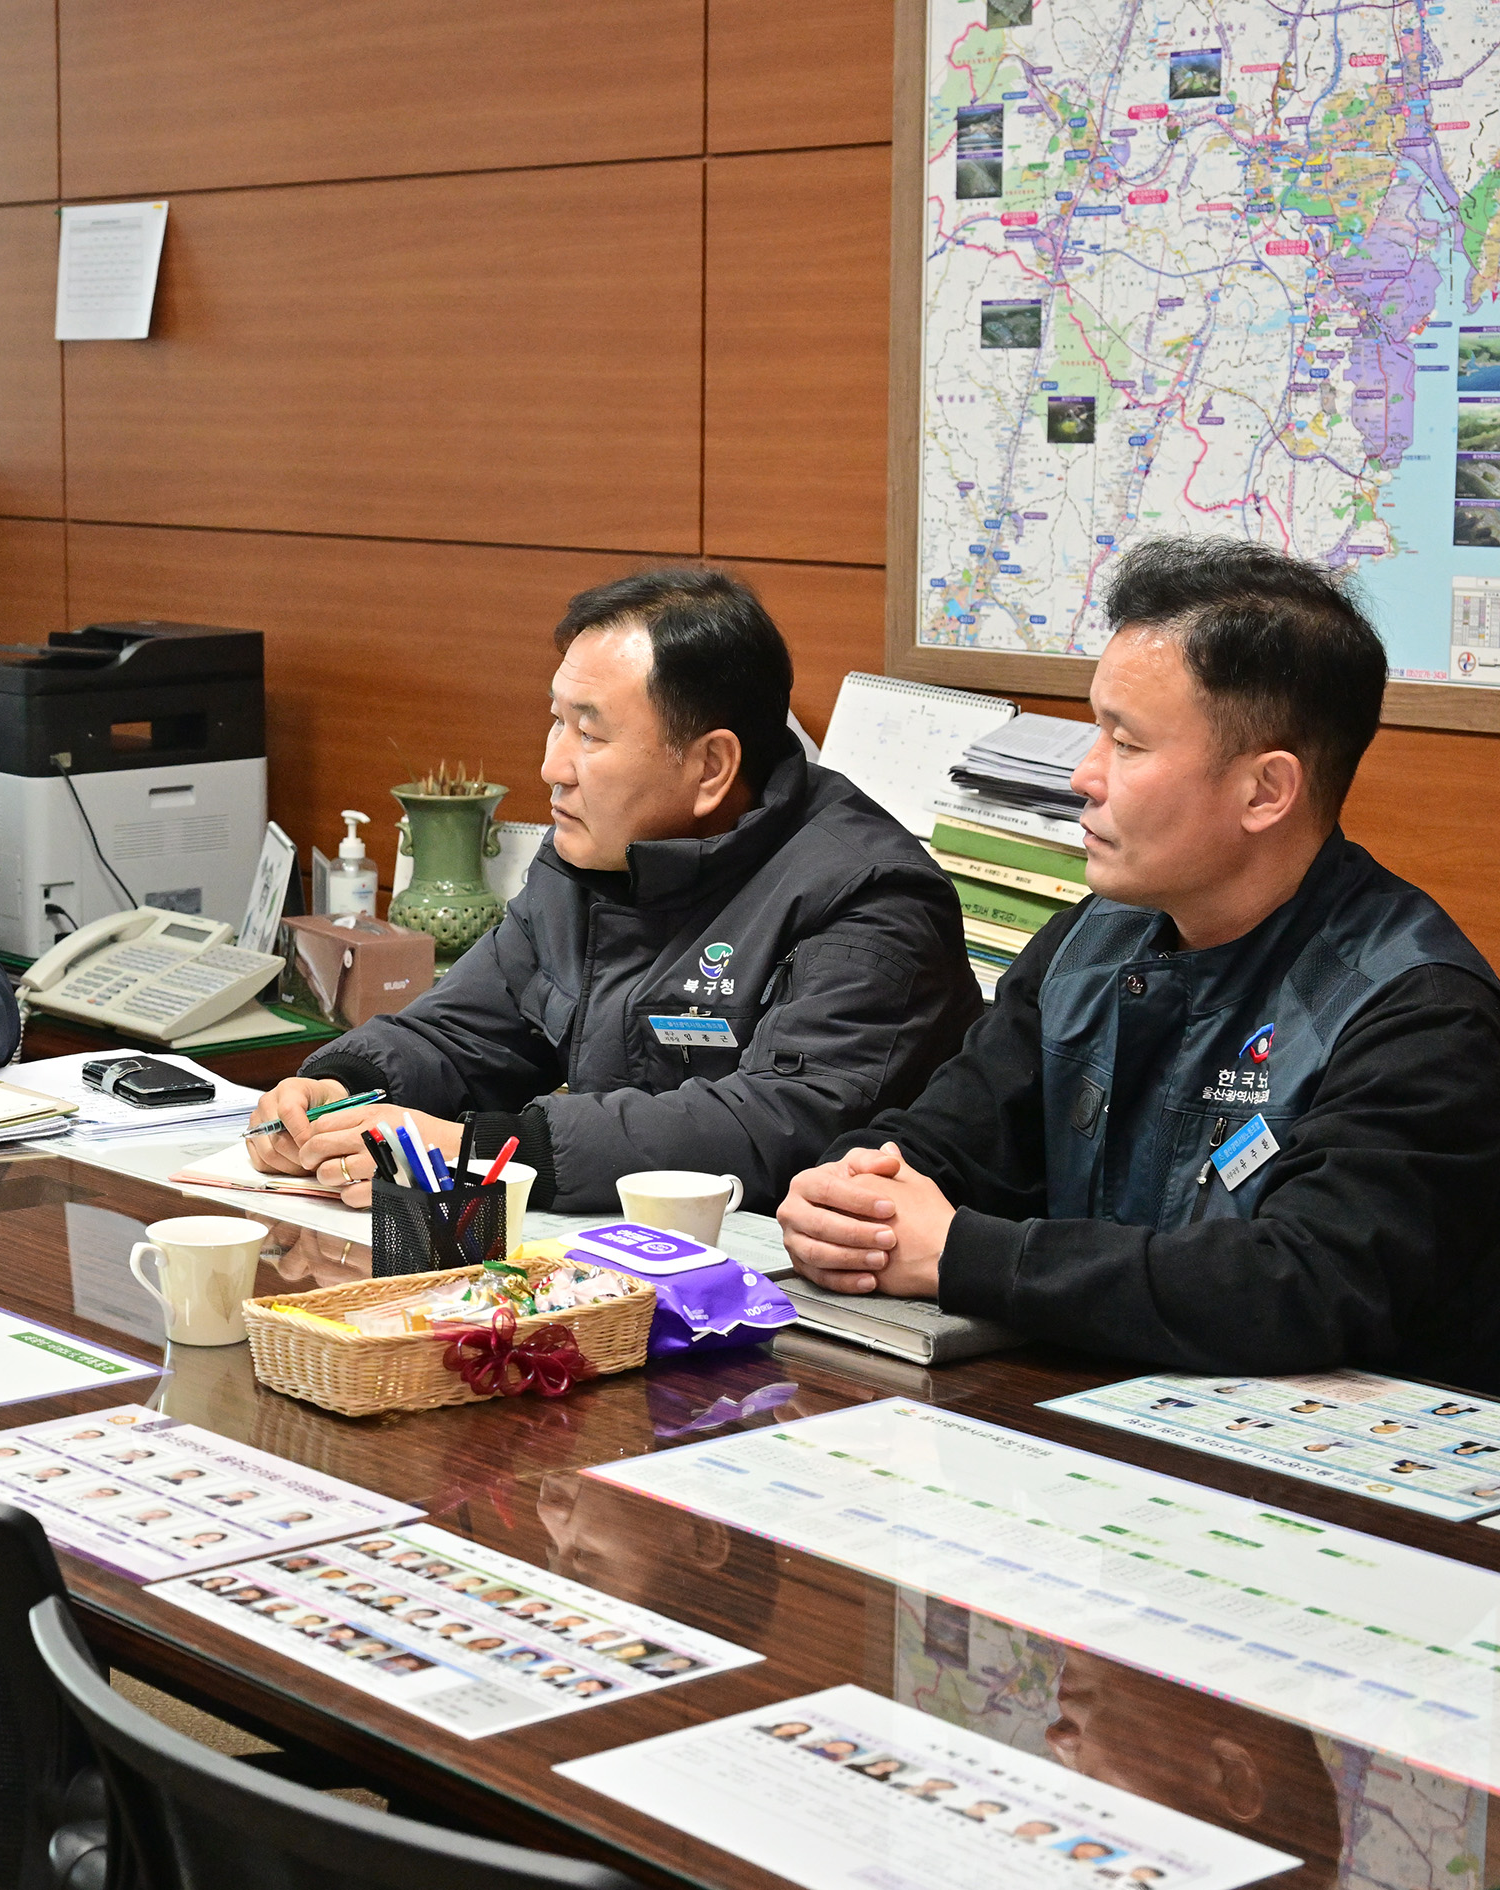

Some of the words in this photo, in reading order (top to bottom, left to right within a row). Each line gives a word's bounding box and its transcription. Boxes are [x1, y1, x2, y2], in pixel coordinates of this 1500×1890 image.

[683, 978, 735, 996] 북구청
[1123, 1418, 1157, 1430] 현황
[1157, 1427, 1192, 1439] 의원
[1253, 1453, 1335, 1477] 울산광역시
